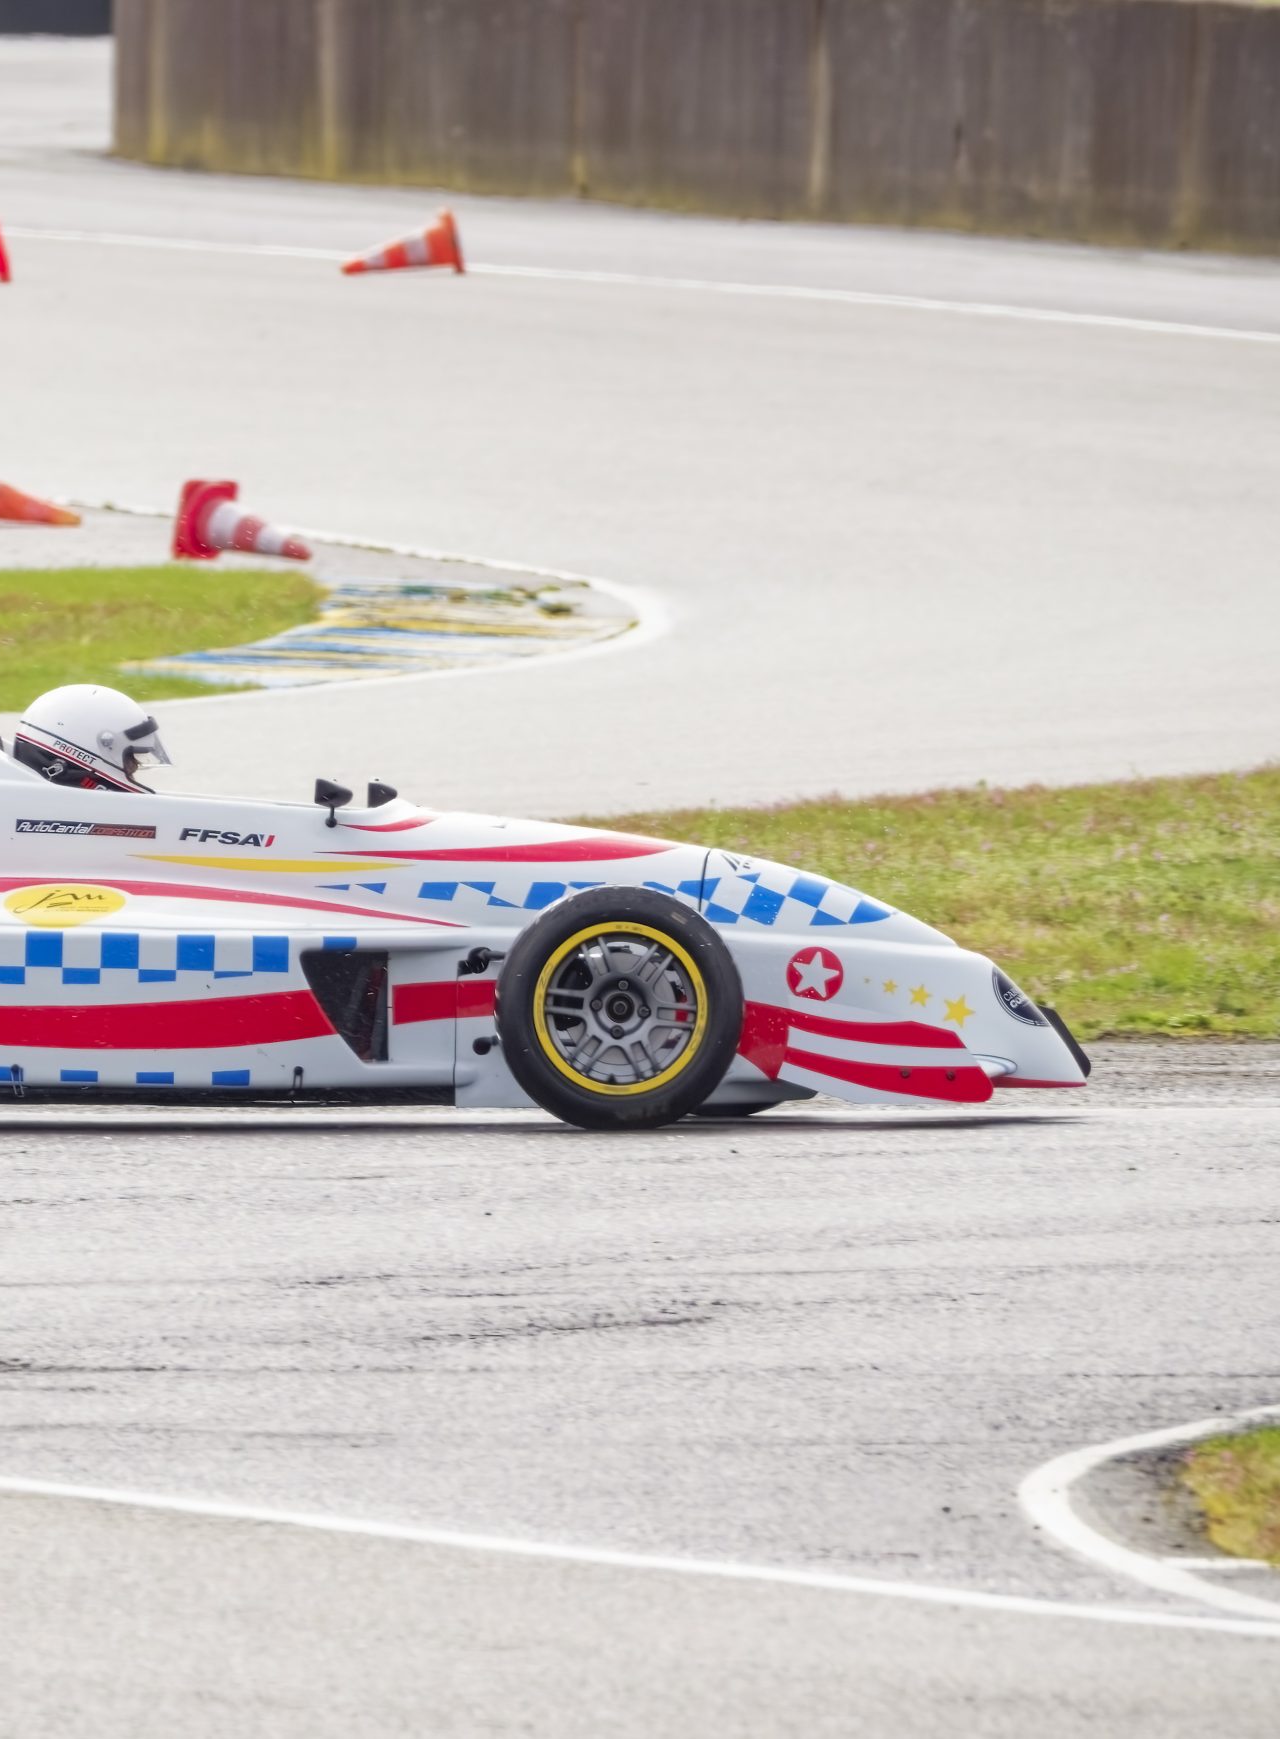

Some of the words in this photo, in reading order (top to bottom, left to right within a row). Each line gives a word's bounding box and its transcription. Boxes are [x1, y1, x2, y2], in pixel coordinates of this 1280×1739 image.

[52, 740, 97, 765] PROTECT
[17, 821, 95, 834] AutoCantal
[178, 827, 265, 847] FFSA
